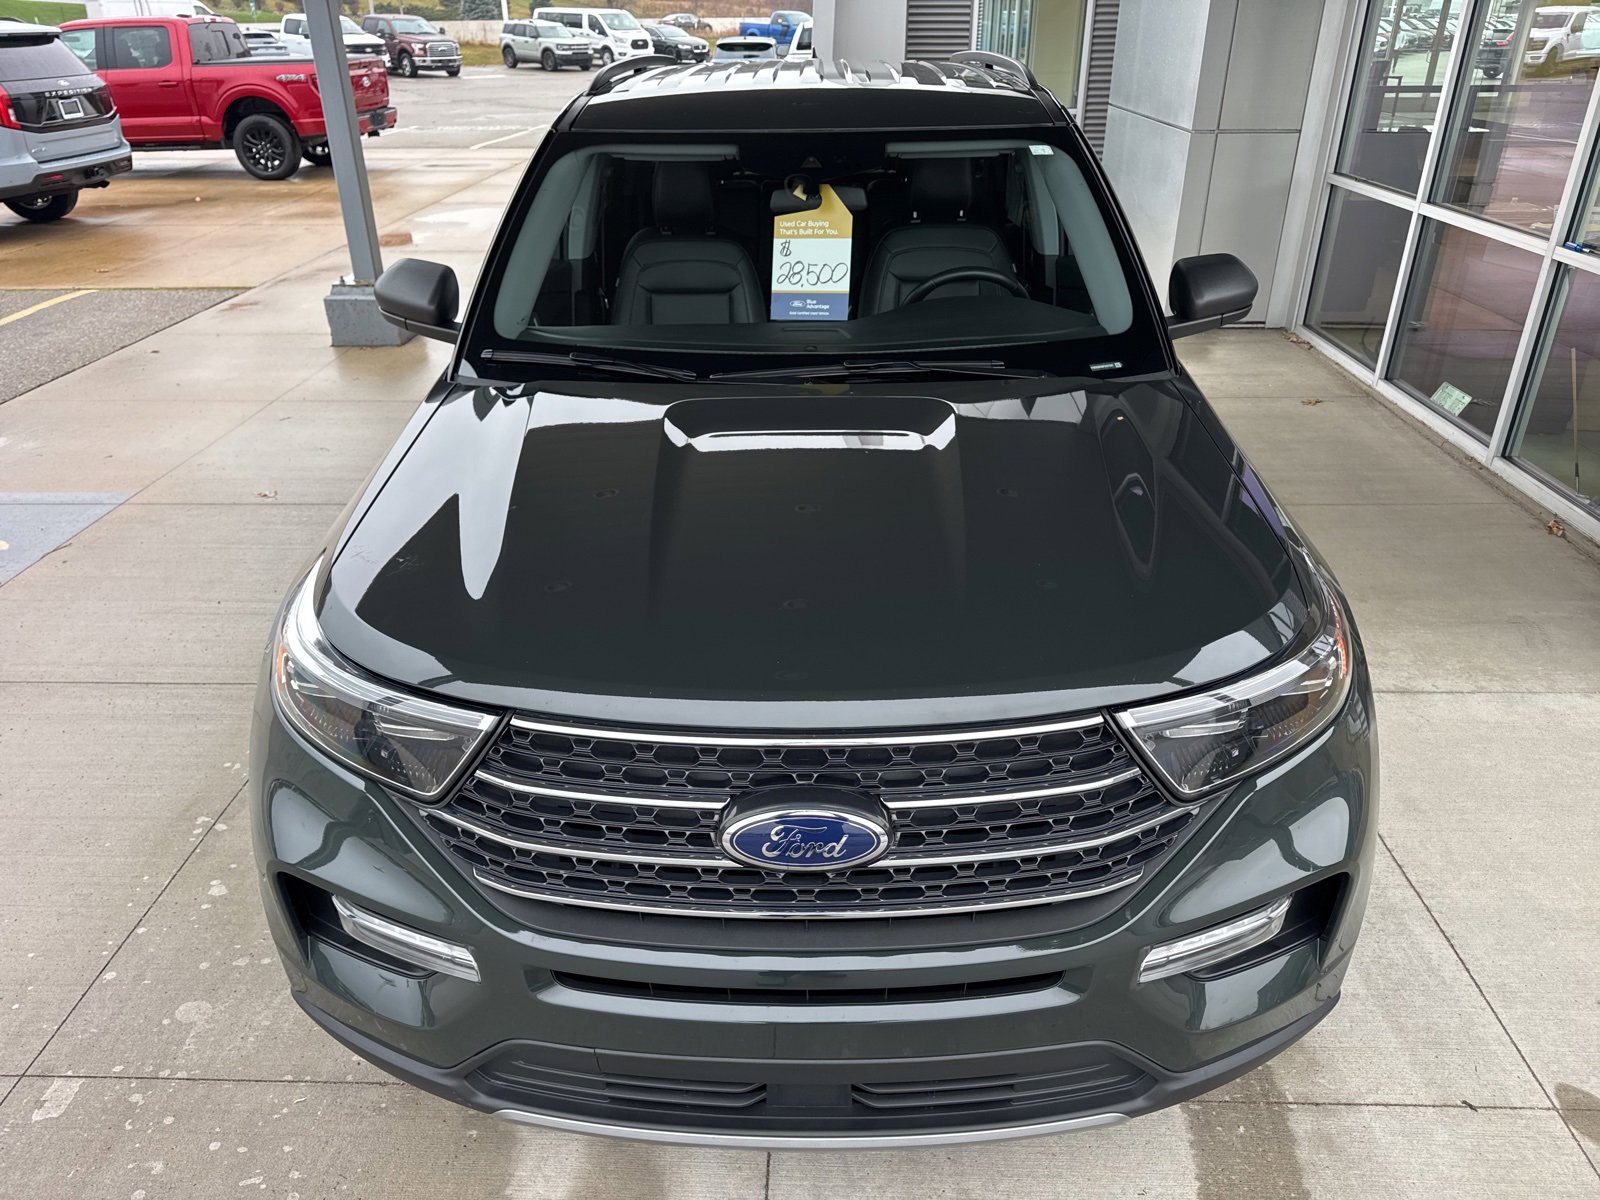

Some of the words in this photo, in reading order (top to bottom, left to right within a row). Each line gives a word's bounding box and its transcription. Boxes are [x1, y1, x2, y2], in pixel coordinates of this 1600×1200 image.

[44, 87, 93, 98] EXPEDITION
[807, 220, 830, 228] Buying
[779, 239, 792, 257] $
[761, 824, 849, 859] Ford
